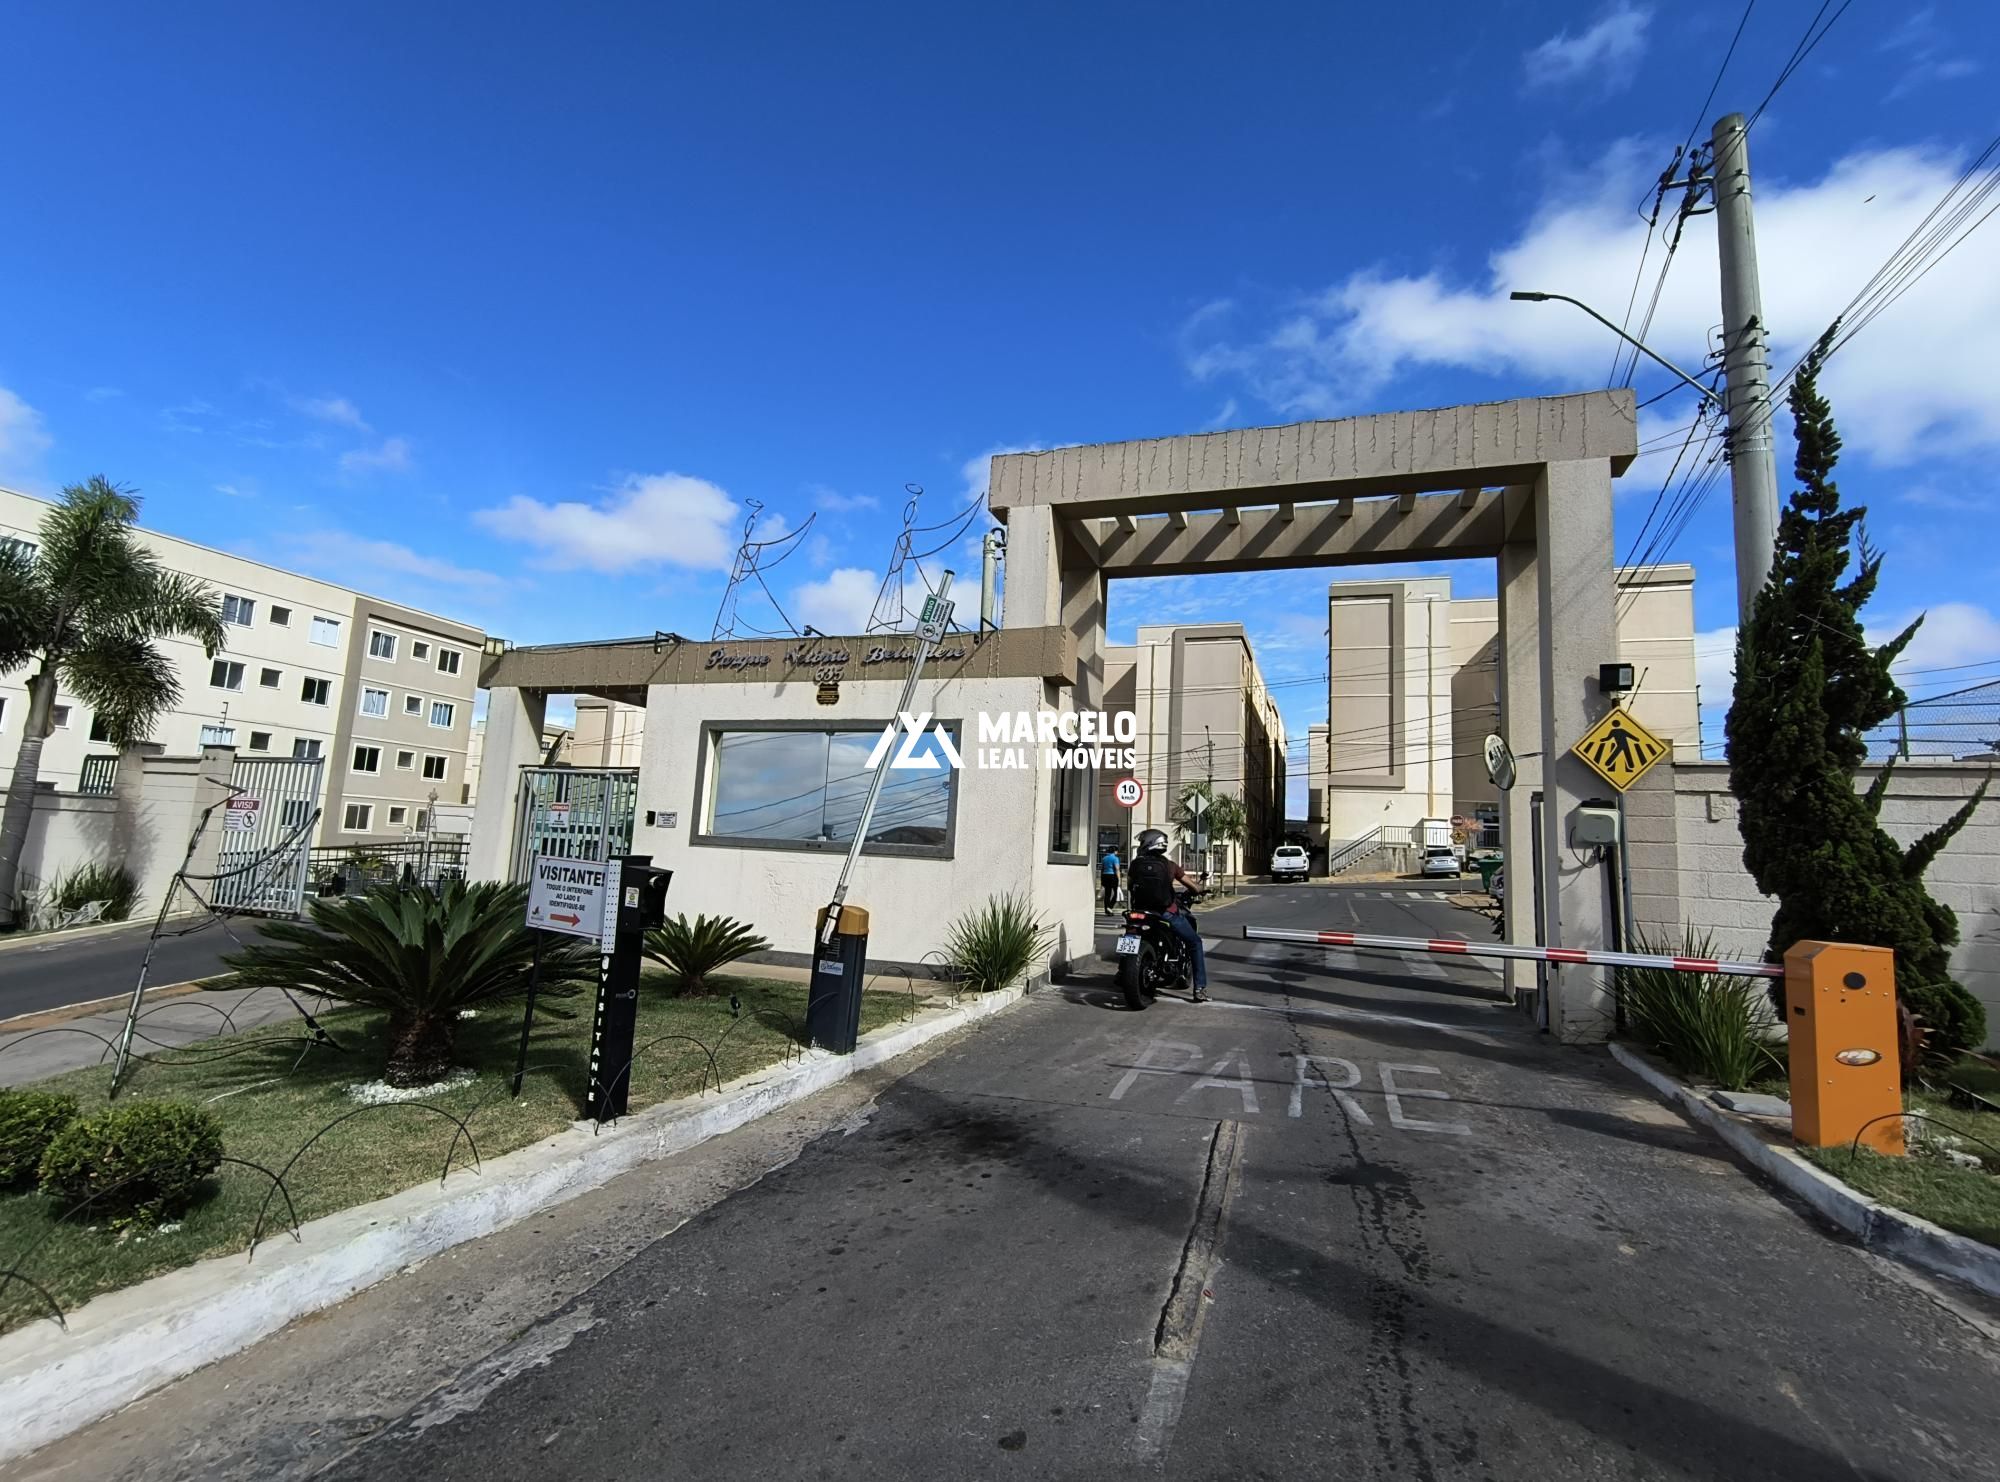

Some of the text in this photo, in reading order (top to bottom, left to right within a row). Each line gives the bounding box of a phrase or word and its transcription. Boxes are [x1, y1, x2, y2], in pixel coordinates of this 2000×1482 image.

[923, 600, 935, 620] AVISO
[706, 648, 770, 672] Parque
[1121, 784, 1135, 794] 10
[232, 800, 254, 809] AVISO
[540, 864, 606, 887] VISITANTE!
[546, 883, 562, 892] TOQUE
[566, 886, 594, 896] INTERFONE
[563, 893, 576, 902] LADO
[549, 900, 586, 911] IDENTIFIQUE-SE
[588, 973, 609, 1102] VISITANTE
[1108, 1039, 1473, 1136] PARE
